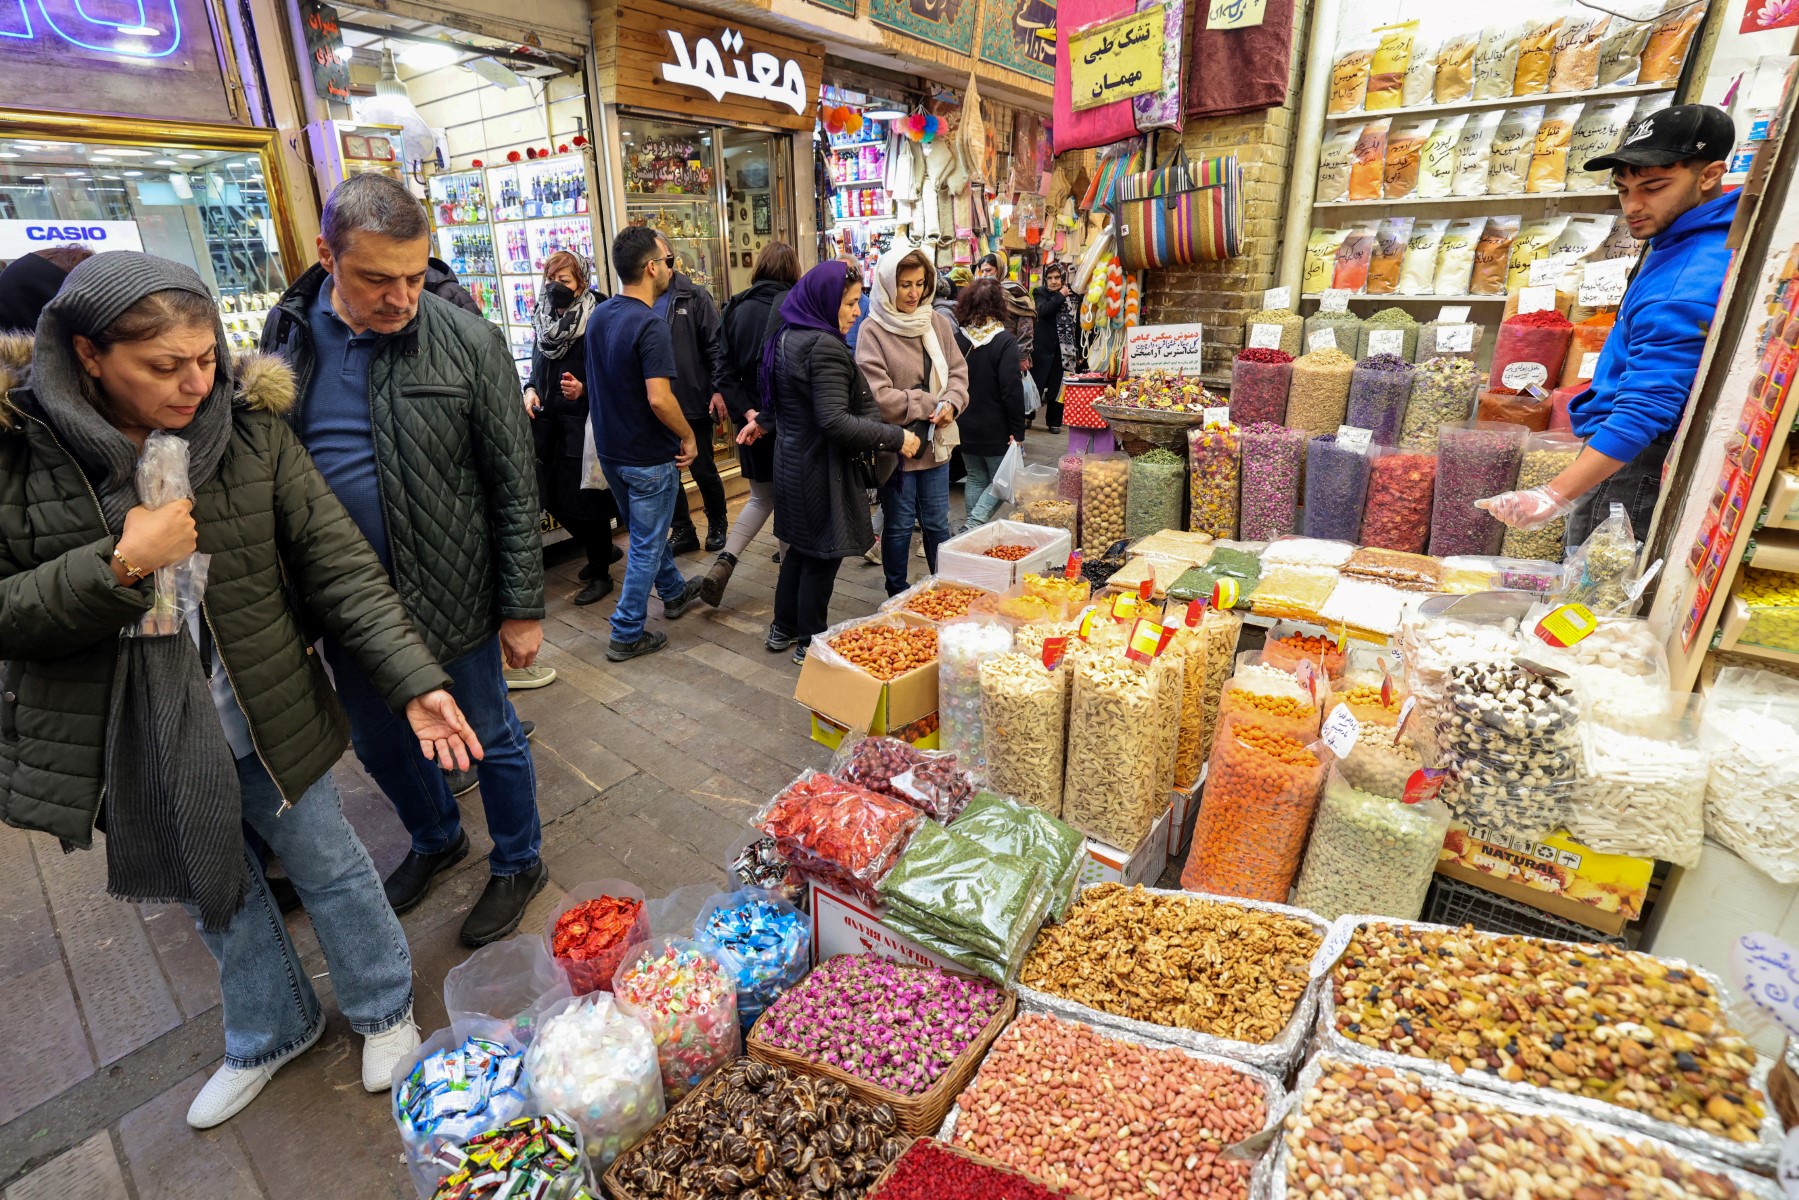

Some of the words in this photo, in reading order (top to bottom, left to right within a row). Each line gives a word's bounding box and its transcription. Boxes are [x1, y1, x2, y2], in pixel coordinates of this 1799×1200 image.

[1117, 22, 1151, 49] تشک
[1083, 35, 1114, 65] طبی
[662, 27, 806, 115] معتمد
[1091, 68, 1143, 98] مهمان
[641, 135, 667, 156] فروش
[1463, 129, 1483, 143] ادویه
[1503, 127, 1525, 142] ادویه
[667, 143, 674, 156] و
[674, 140, 694, 159] خرید
[26, 227, 107, 241] CASIO
[1130, 333, 1151, 343] گیاهی
[1473, 854, 1521, 876] DRIED
[1524, 870, 1561, 890] FIGS
[1481, 845, 1558, 876] NATURAL
[844, 916, 881, 942] BRAND
[884, 936, 944, 969] AHLEVAN
